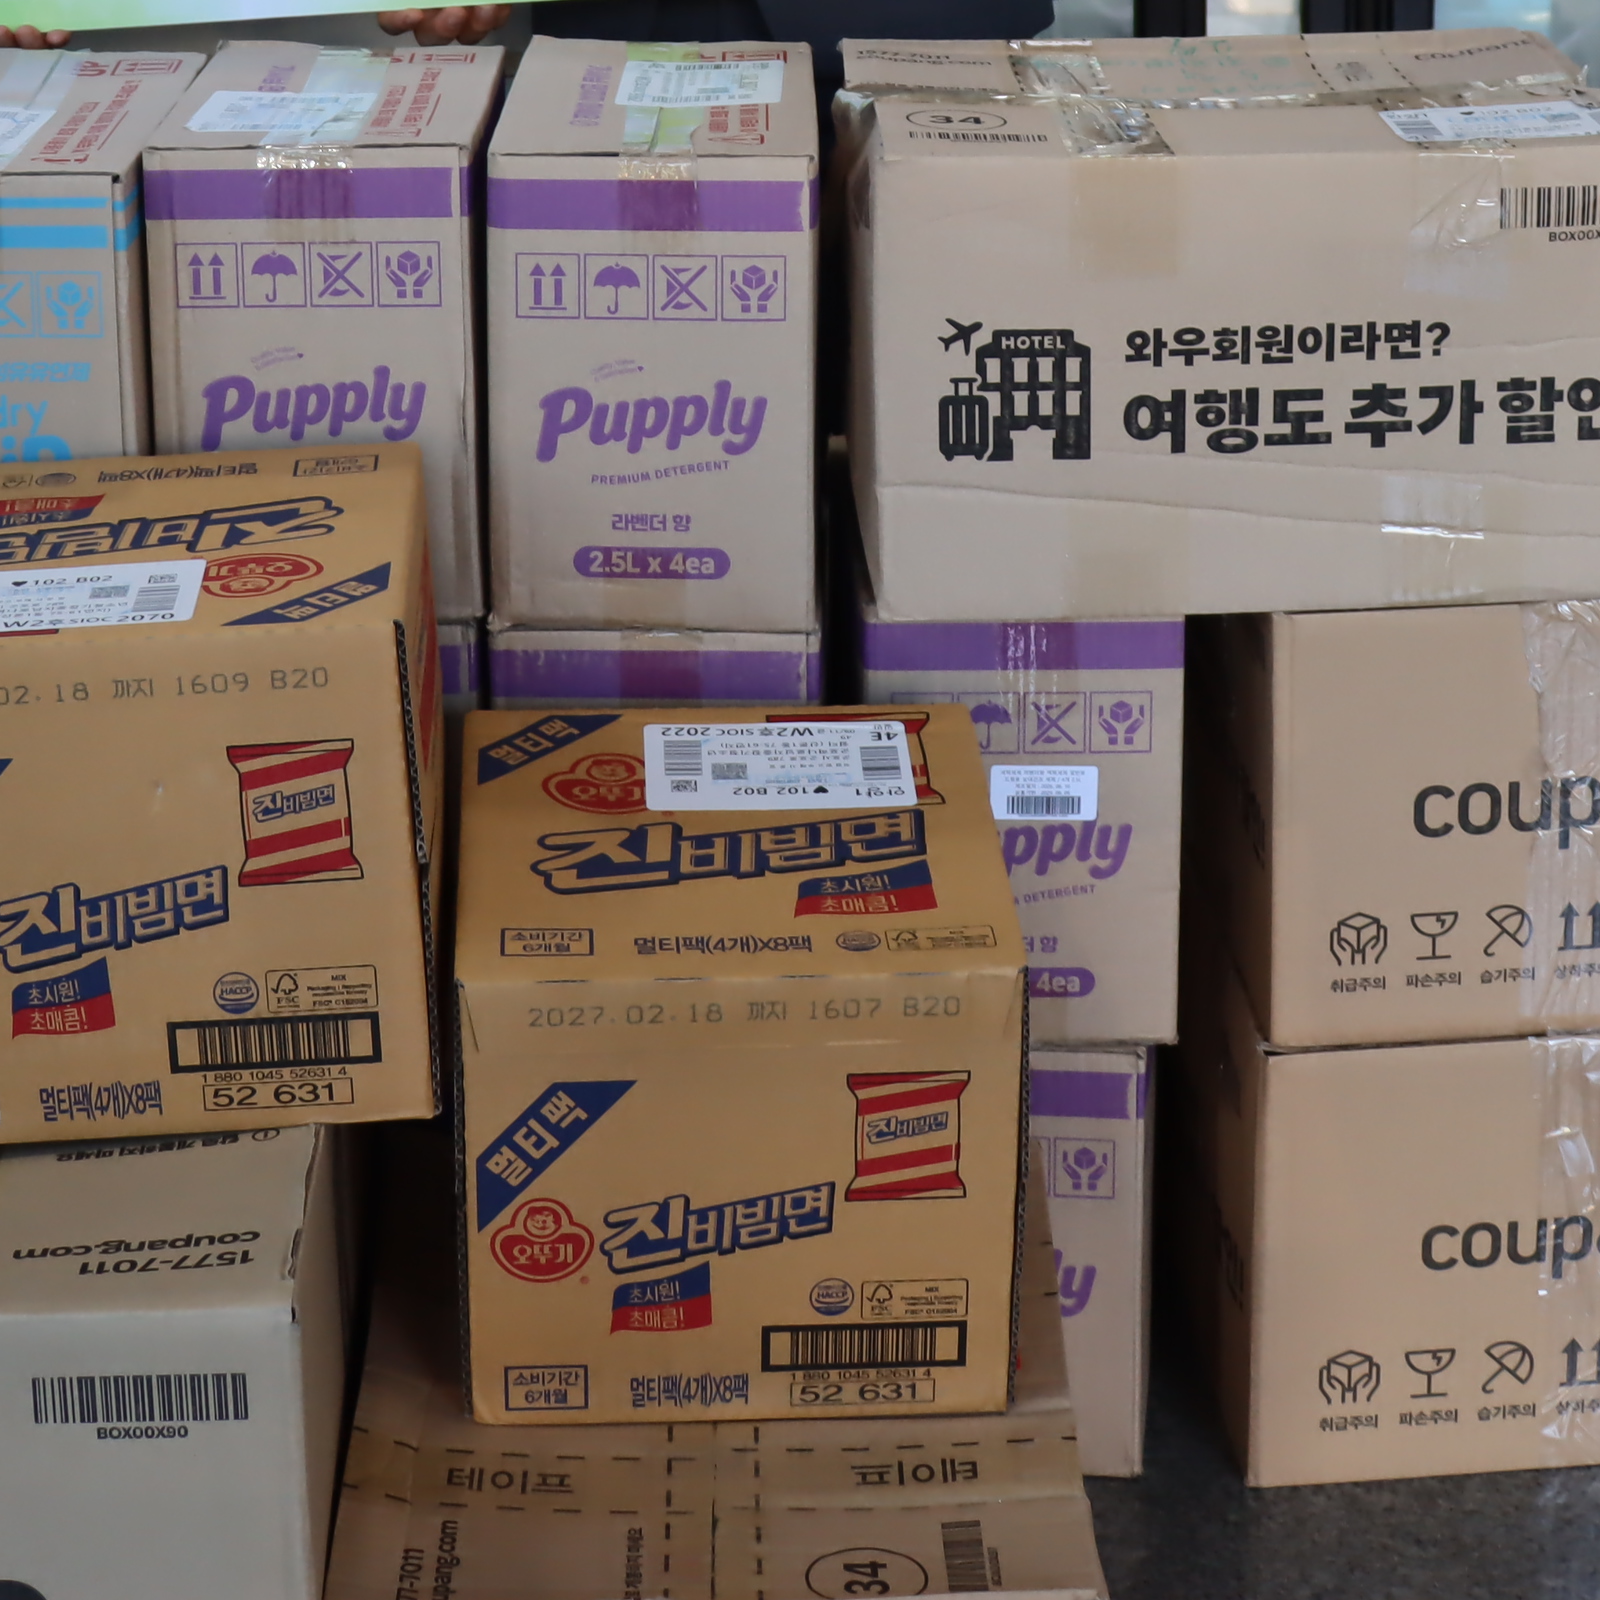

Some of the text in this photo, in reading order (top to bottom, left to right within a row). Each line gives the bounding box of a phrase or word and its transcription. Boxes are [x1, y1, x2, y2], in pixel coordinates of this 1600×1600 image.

[928, 114, 986, 125] 34
[1000, 335, 1068, 351] HOTEL
[1124, 320, 1452, 367] 와우회원이라면?
[200, 365, 427, 451] Pupply
[1123, 386, 1334, 455] 여행도
[1343, 379, 1485, 450] 추가
[537, 378, 768, 465] Pupply
[589, 459, 730, 486] PREMIUM DETERGENT
[610, 512, 692, 534] 라벤더 향
[588, 549, 716, 577] 2.5L x 4ea
[111, 677, 155, 699] 까지
[175, 673, 250, 697] 1609
[269, 667, 329, 691] B20
[485, 716, 571, 766] 멀티팩
[252, 785, 336, 823] 진비빔면
[530, 809, 926, 895] 진비빔면
[820, 873, 890, 894] 초시원!
[820, 894, 897, 915] 초매콤!
[510, 930, 581, 943] 소비기간
[522, 940, 573, 954] 6개월
[1036, 972, 1081, 995] 4ea
[1329, 974, 1387, 993] 취급주의
[1405, 969, 1462, 988] 파손주의
[1479, 964, 1536, 984] 습기주의
[28, 981, 80, 1006] 초시원!
[220, 986, 253, 997] HACCP
[29, 1007, 88, 1034] 초매콤!
[527, 996, 961, 1028] 2027.02.18 까지 1607 B20
[212, 1082, 336, 1108] 52 631
[485, 1090, 589, 1188] 멀티팩
[601, 1182, 836, 1274] 진비빔면
[14, 1229, 263, 1263] coupang.com
[511, 1240, 574, 1266] 오뚜기
[78, 1248, 256, 1278] 1577-7011
[628, 1280, 680, 1305] 초시원!
[630, 1305, 686, 1330] 초매콤!
[511, 1369, 580, 1389] 소비기간
[524, 1386, 569, 1406] 6개월
[799, 1382, 918, 1403] 52 631
[1318, 1411, 1379, 1431] 취급주의
[1398, 1406, 1459, 1426] 파손주의
[1476, 1401, 1537, 1421] 습기주의
[446, 1466, 575, 1494] 테이프
[850, 1458, 979, 1487] 테이프
[844, 1559, 891, 1597] 34
